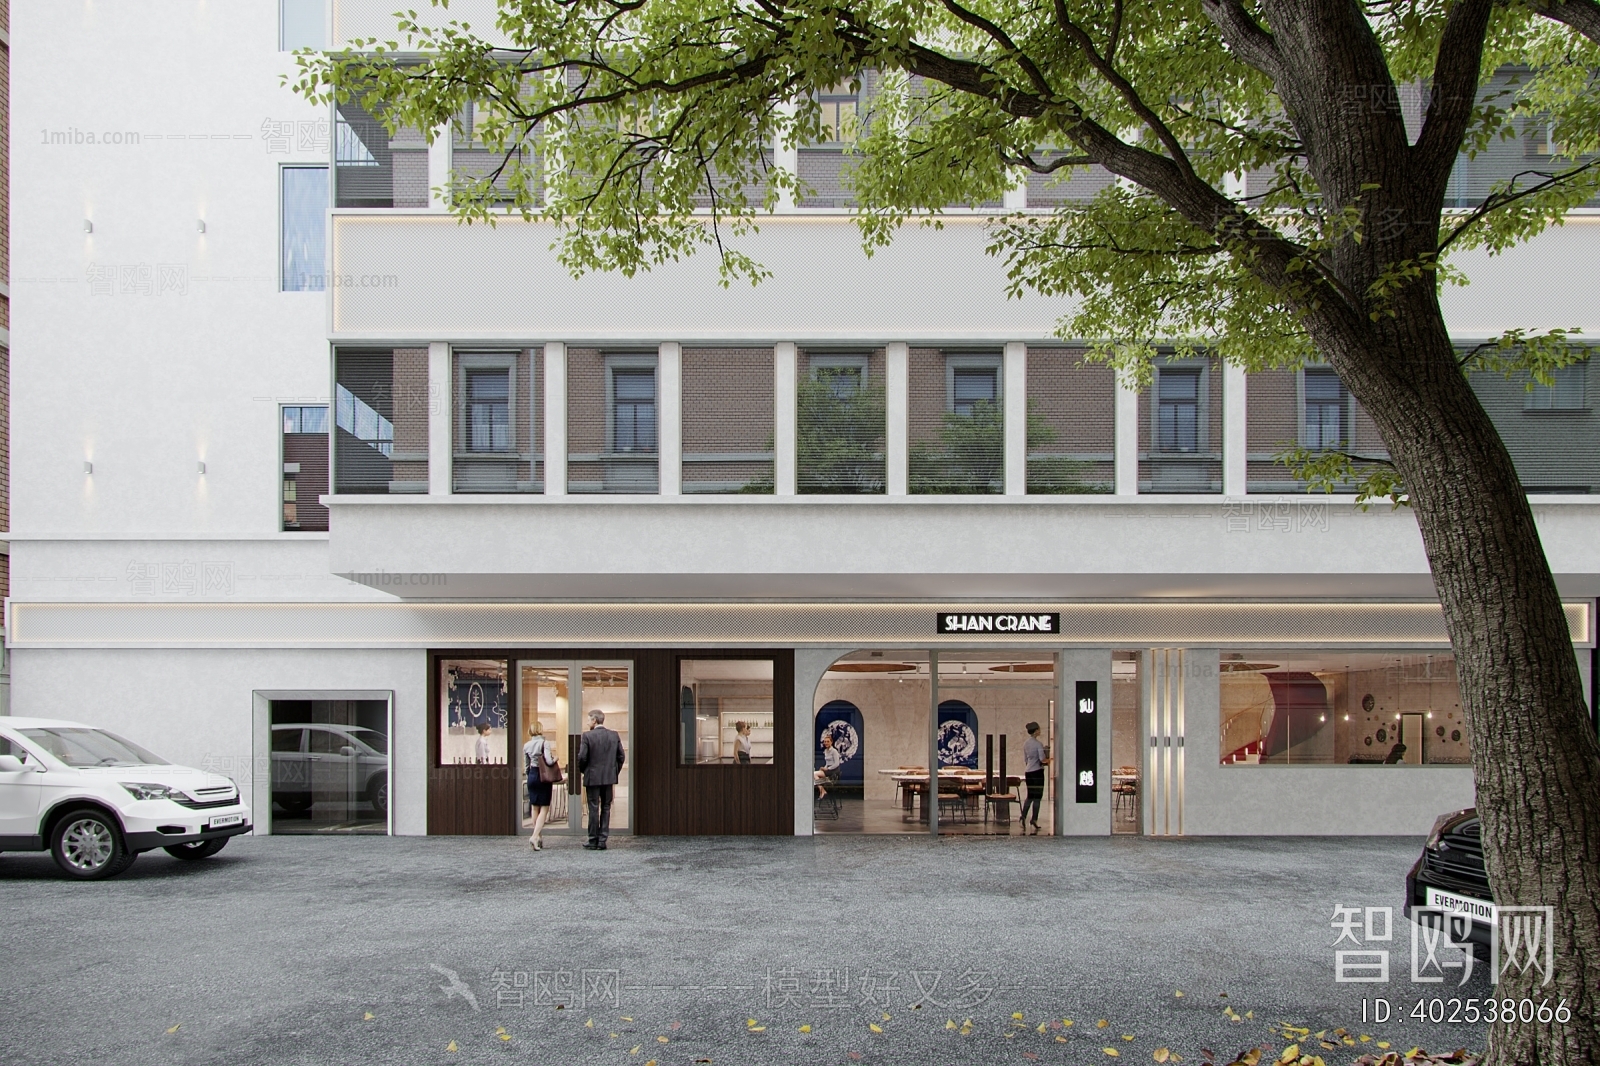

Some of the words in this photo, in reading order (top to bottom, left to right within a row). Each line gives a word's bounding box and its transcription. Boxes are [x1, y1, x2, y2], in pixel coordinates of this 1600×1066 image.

[945, 615, 993, 631] SHAN
[995, 615, 1052, 631] CRANE
[213, 816, 240, 825] EVERMOTION
